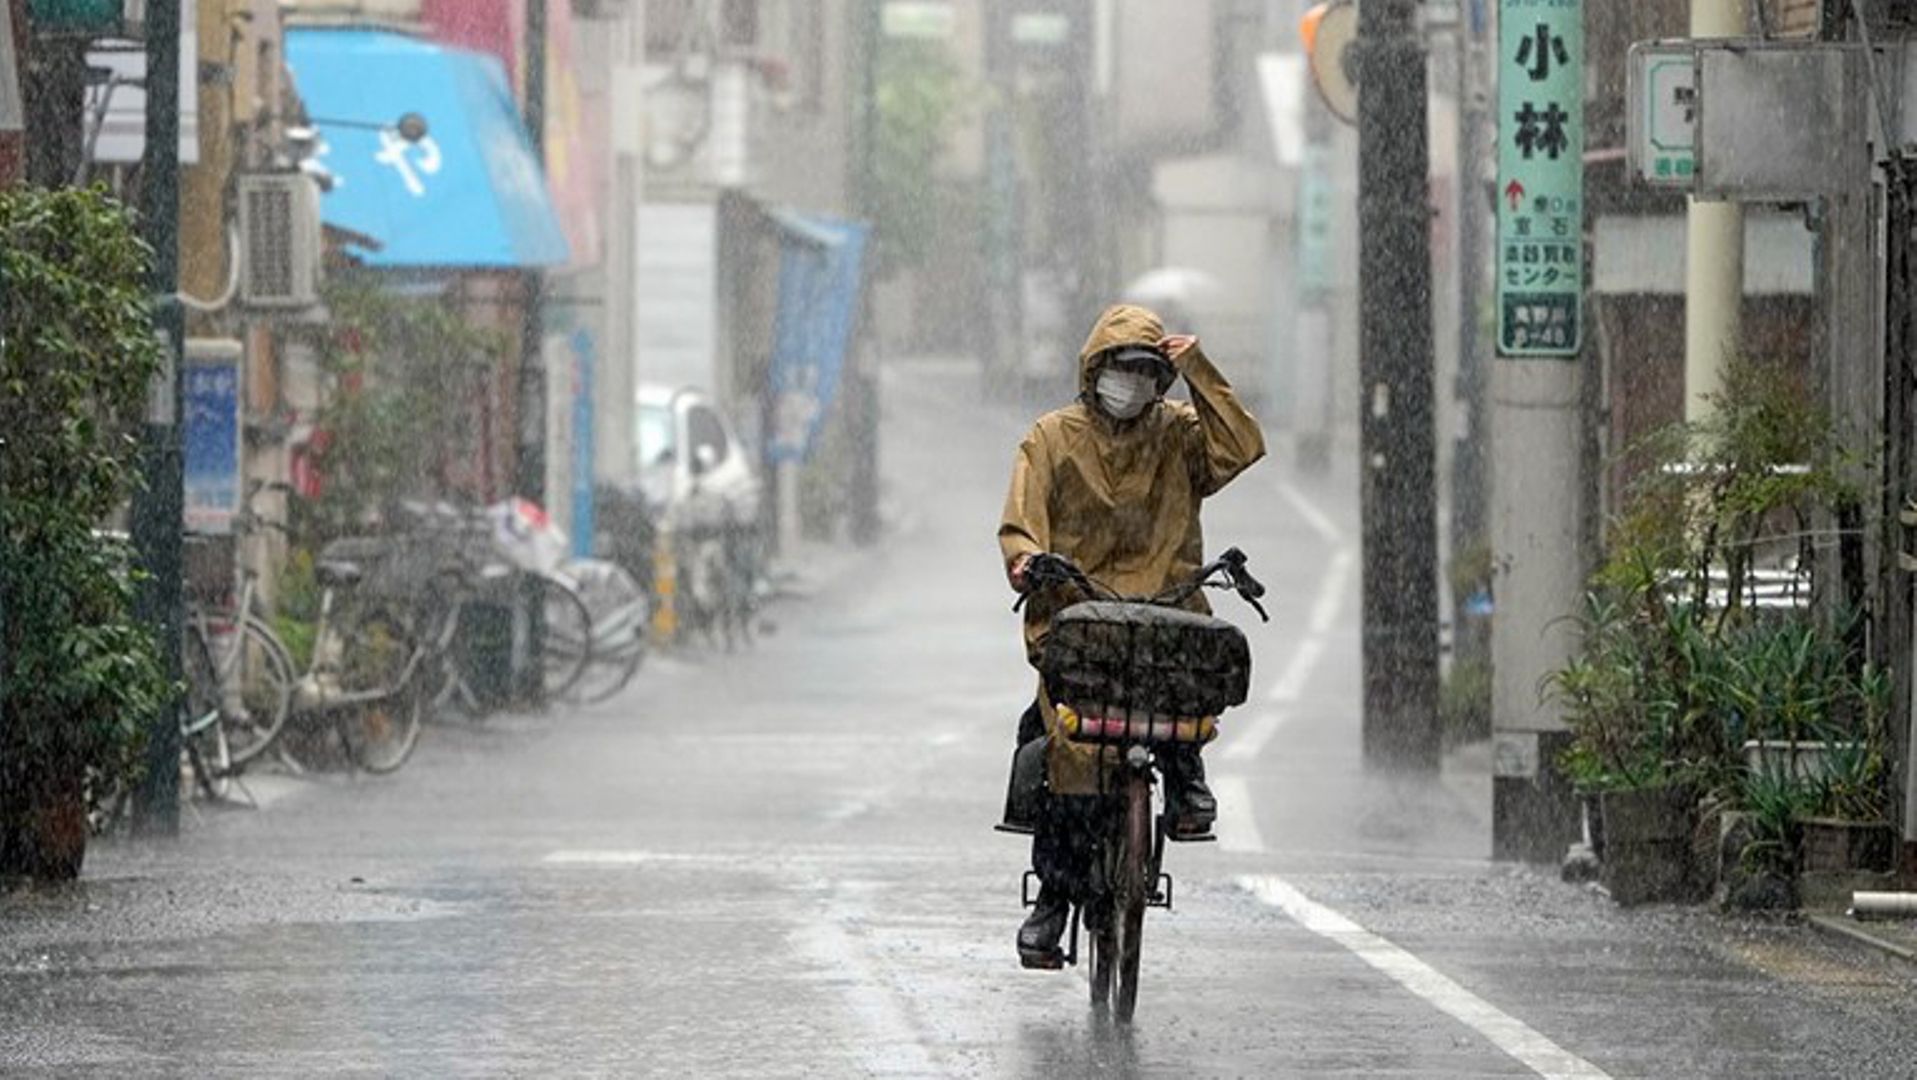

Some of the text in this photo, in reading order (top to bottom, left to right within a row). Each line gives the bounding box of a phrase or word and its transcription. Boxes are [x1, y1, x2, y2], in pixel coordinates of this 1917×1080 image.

[1514, 23, 1569, 160] 小林
[1506, 267, 1577, 286] センター
